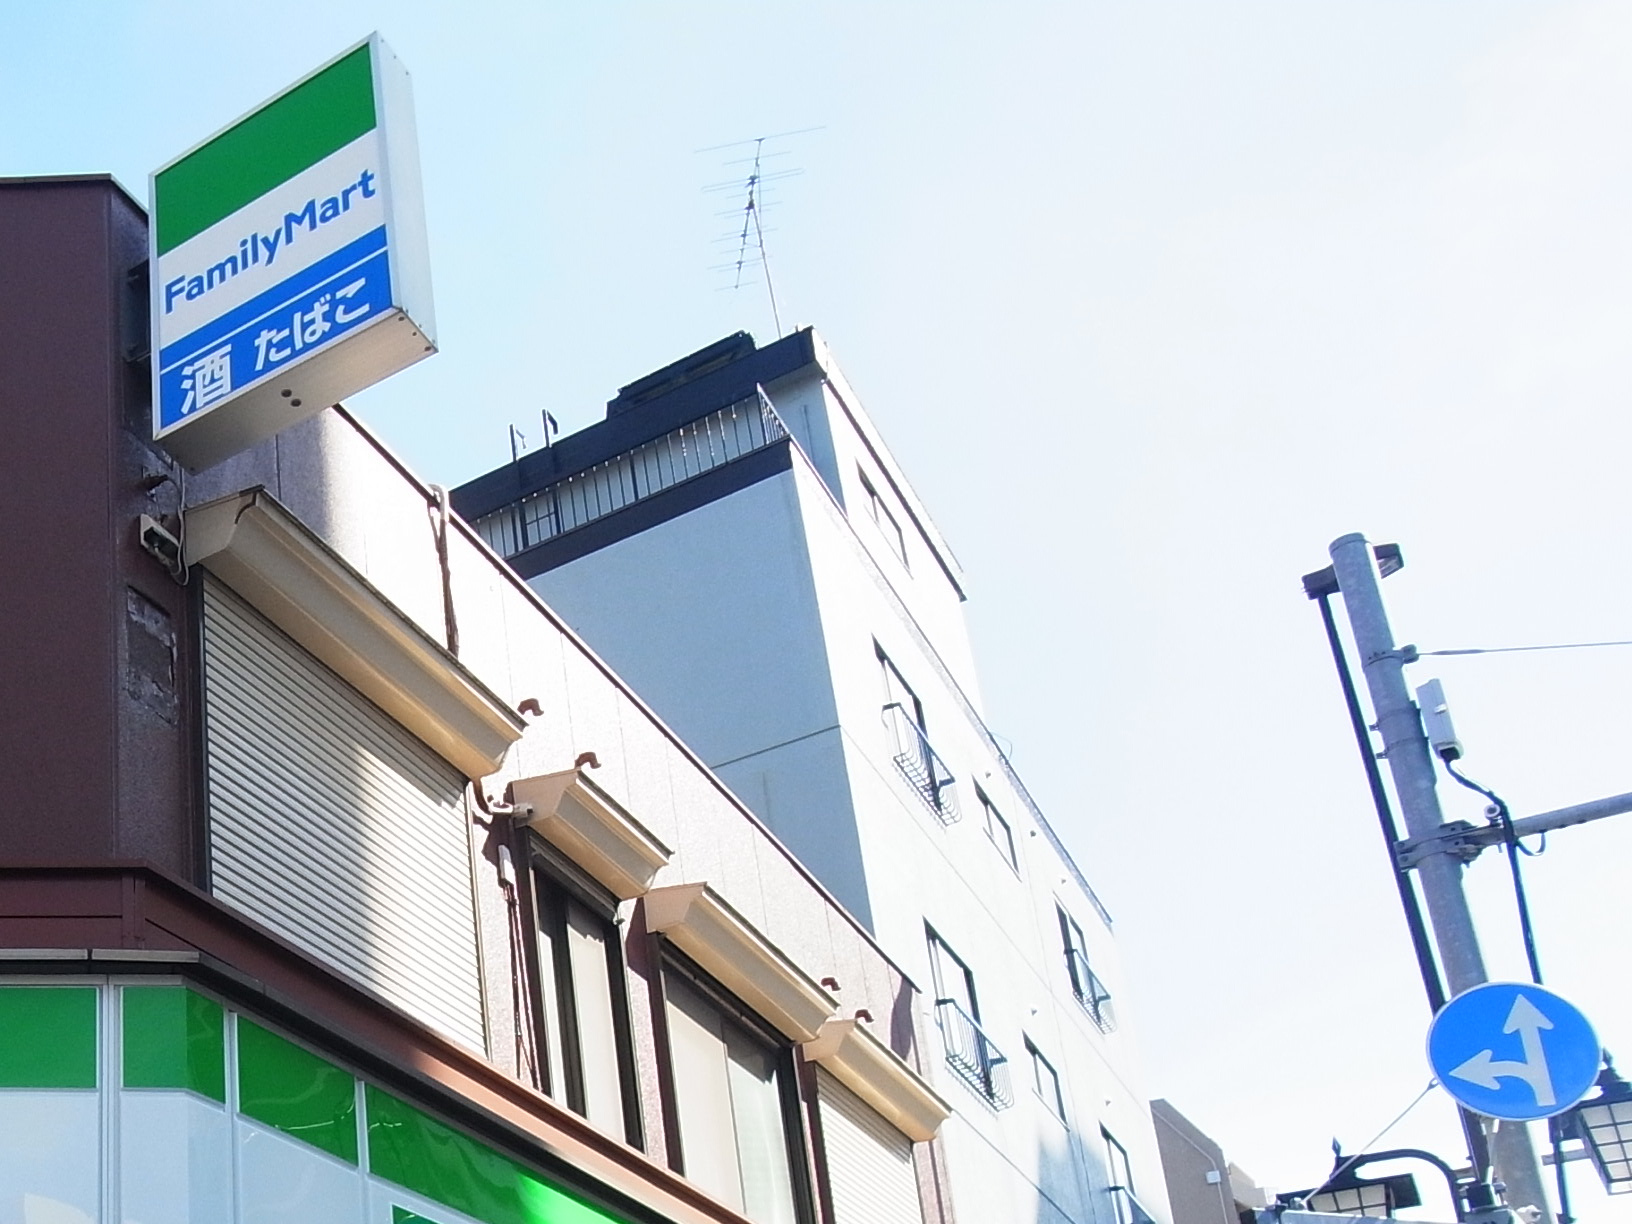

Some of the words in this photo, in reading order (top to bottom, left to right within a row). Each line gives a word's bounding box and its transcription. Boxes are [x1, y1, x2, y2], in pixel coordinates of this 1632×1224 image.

[164, 168, 376, 315] FamilyMart
[180, 343, 232, 415] 酒
[254, 277, 370, 372] たばこ
